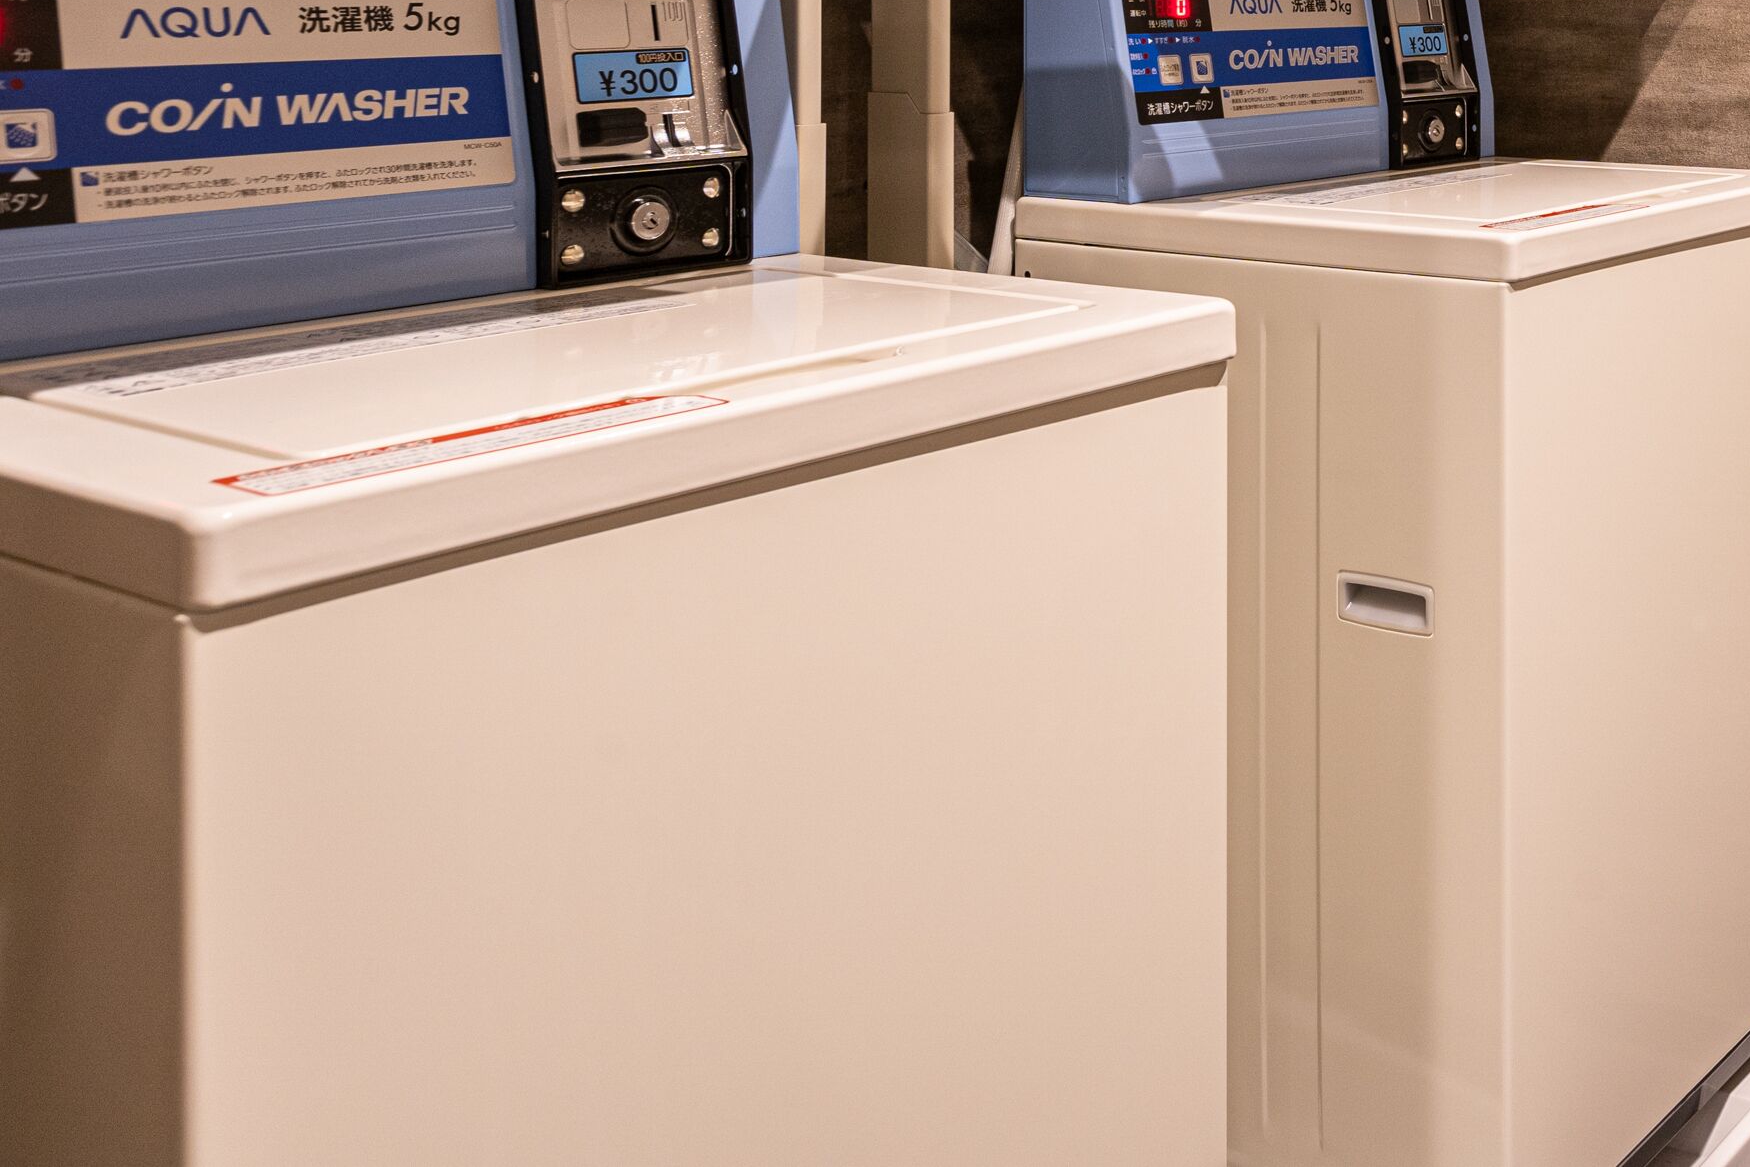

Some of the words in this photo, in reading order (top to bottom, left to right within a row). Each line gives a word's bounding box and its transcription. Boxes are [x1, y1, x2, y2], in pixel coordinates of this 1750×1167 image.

[120, 6, 271, 39] AQUA
[298, 5, 394, 34] 洗濯機
[403, 2, 460, 36] 5kg
[13, 48, 33, 62] 分
[1409, 36, 1442, 53] ¥300
[1287, 45, 1359, 67] WASHER
[599, 67, 678, 97] ¥300
[276, 87, 469, 125] WASHER
[1147, 100, 1214, 116] 洗濯槽シャワーボタン
[104, 166, 214, 183] 洗濯槽シャワーボタン
